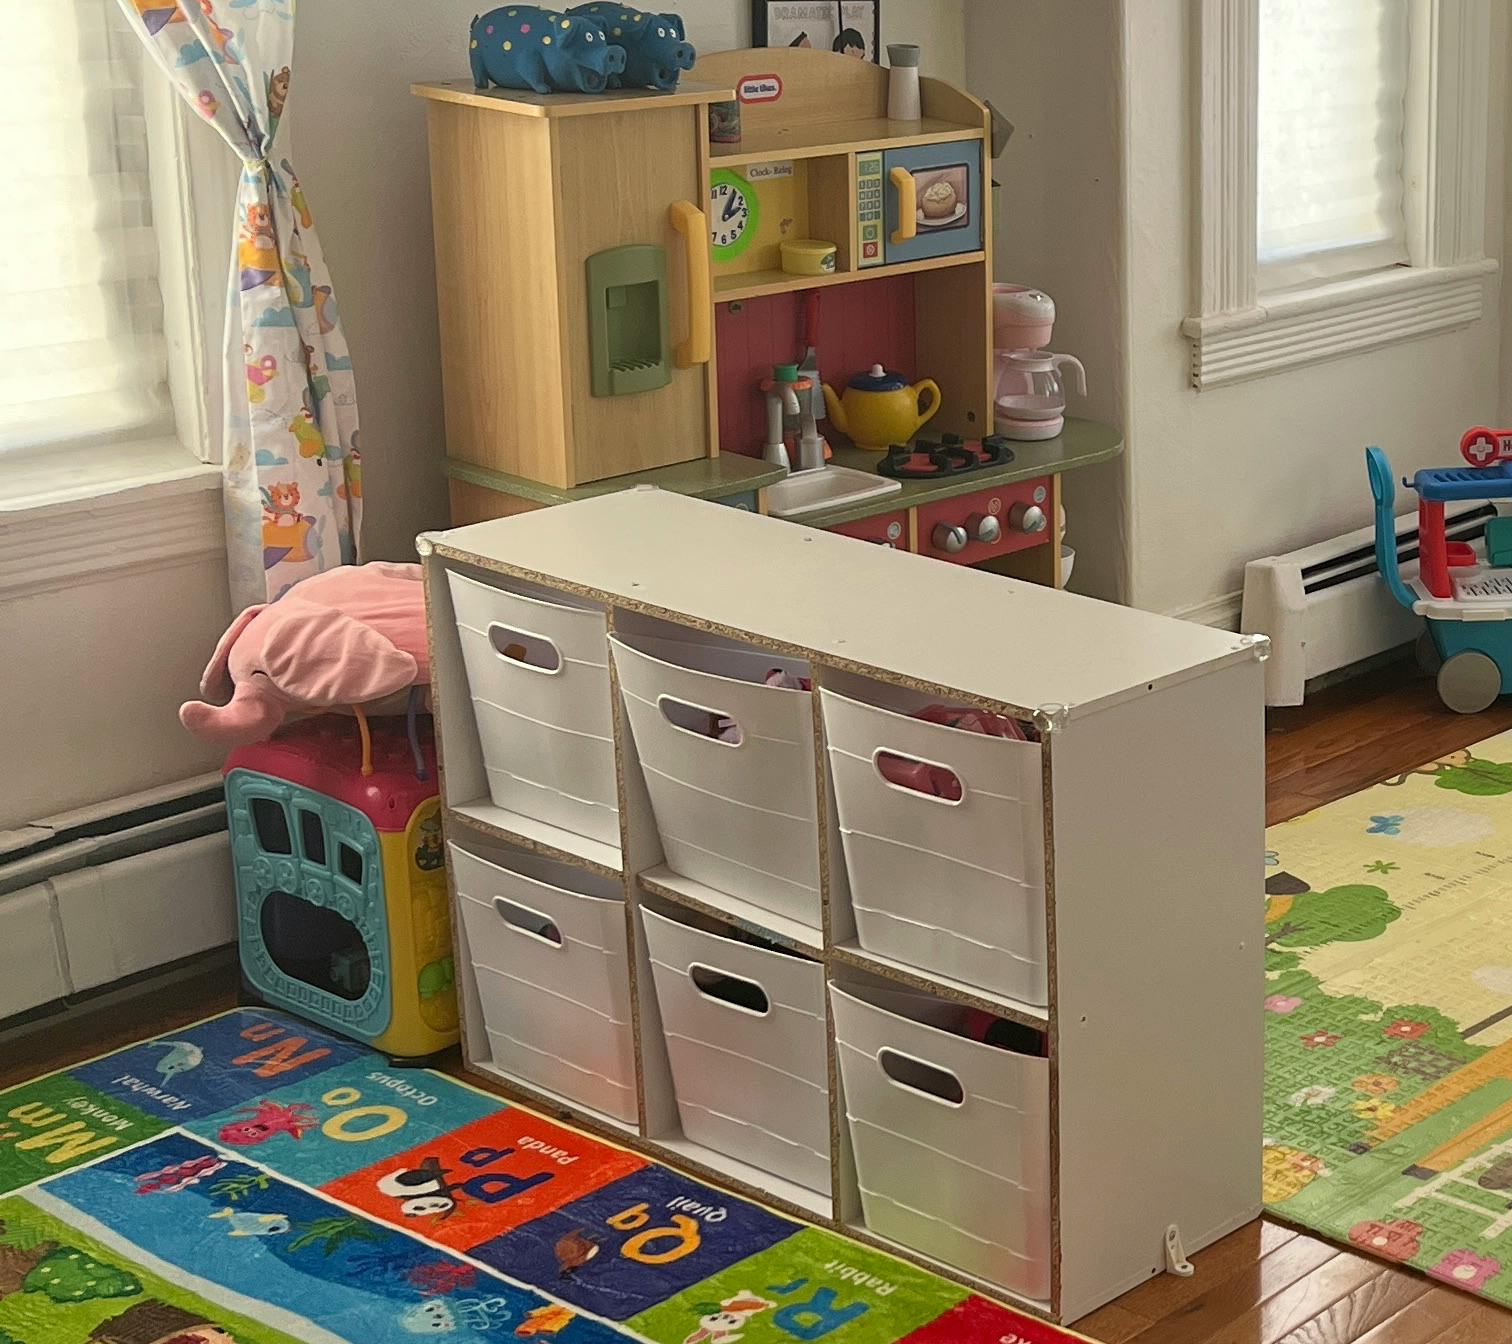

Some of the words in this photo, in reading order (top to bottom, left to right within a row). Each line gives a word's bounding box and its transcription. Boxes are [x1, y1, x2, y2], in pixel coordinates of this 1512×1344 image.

[720, 185, 728, 196] 12
[721, 234, 727, 244] 6
[730, 230, 737, 240] 5
[737, 221, 743, 231] 4
[231, 1022, 332, 1078] Nn
[112, 1074, 192, 1111] Narwhal
[367, 1071, 438, 1106] Octopus
[62, 1096, 135, 1131] Monkey
[321, 1087, 408, 1142] Oo
[8, 1102, 118, 1163] Mm
[517, 1135, 579, 1165] Panda
[459, 1146, 555, 1204] Pp
[665, 1196, 728, 1223] Quail
[606, 1202, 701, 1265] Qq
[823, 1259, 898, 1297] Rabbit
[766, 1277, 871, 1341] Rr
